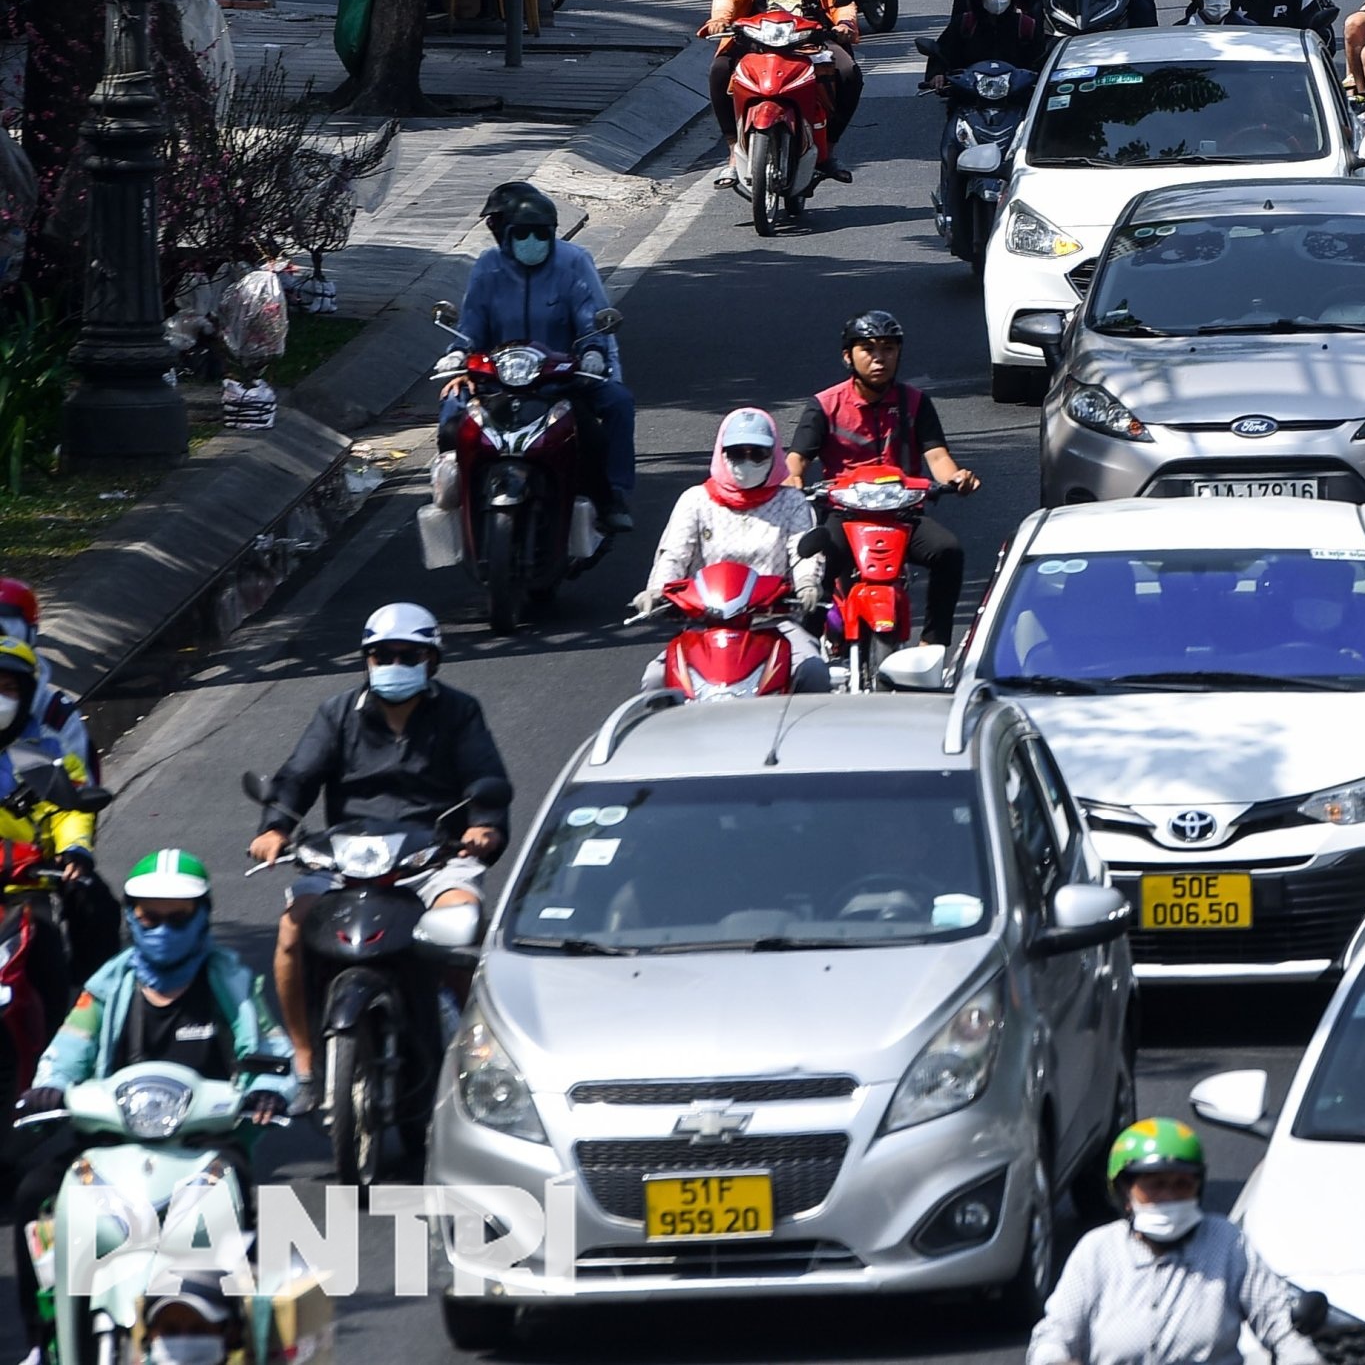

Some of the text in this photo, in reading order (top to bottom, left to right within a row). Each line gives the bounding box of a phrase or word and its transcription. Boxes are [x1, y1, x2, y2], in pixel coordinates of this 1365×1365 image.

[1240, 420, 1268, 432] Ford
[1172, 876, 1219, 899] 50E
[1153, 902, 1240, 926] 006.50
[680, 1178, 735, 1205] 51F
[659, 1208, 760, 1235] 959.20
